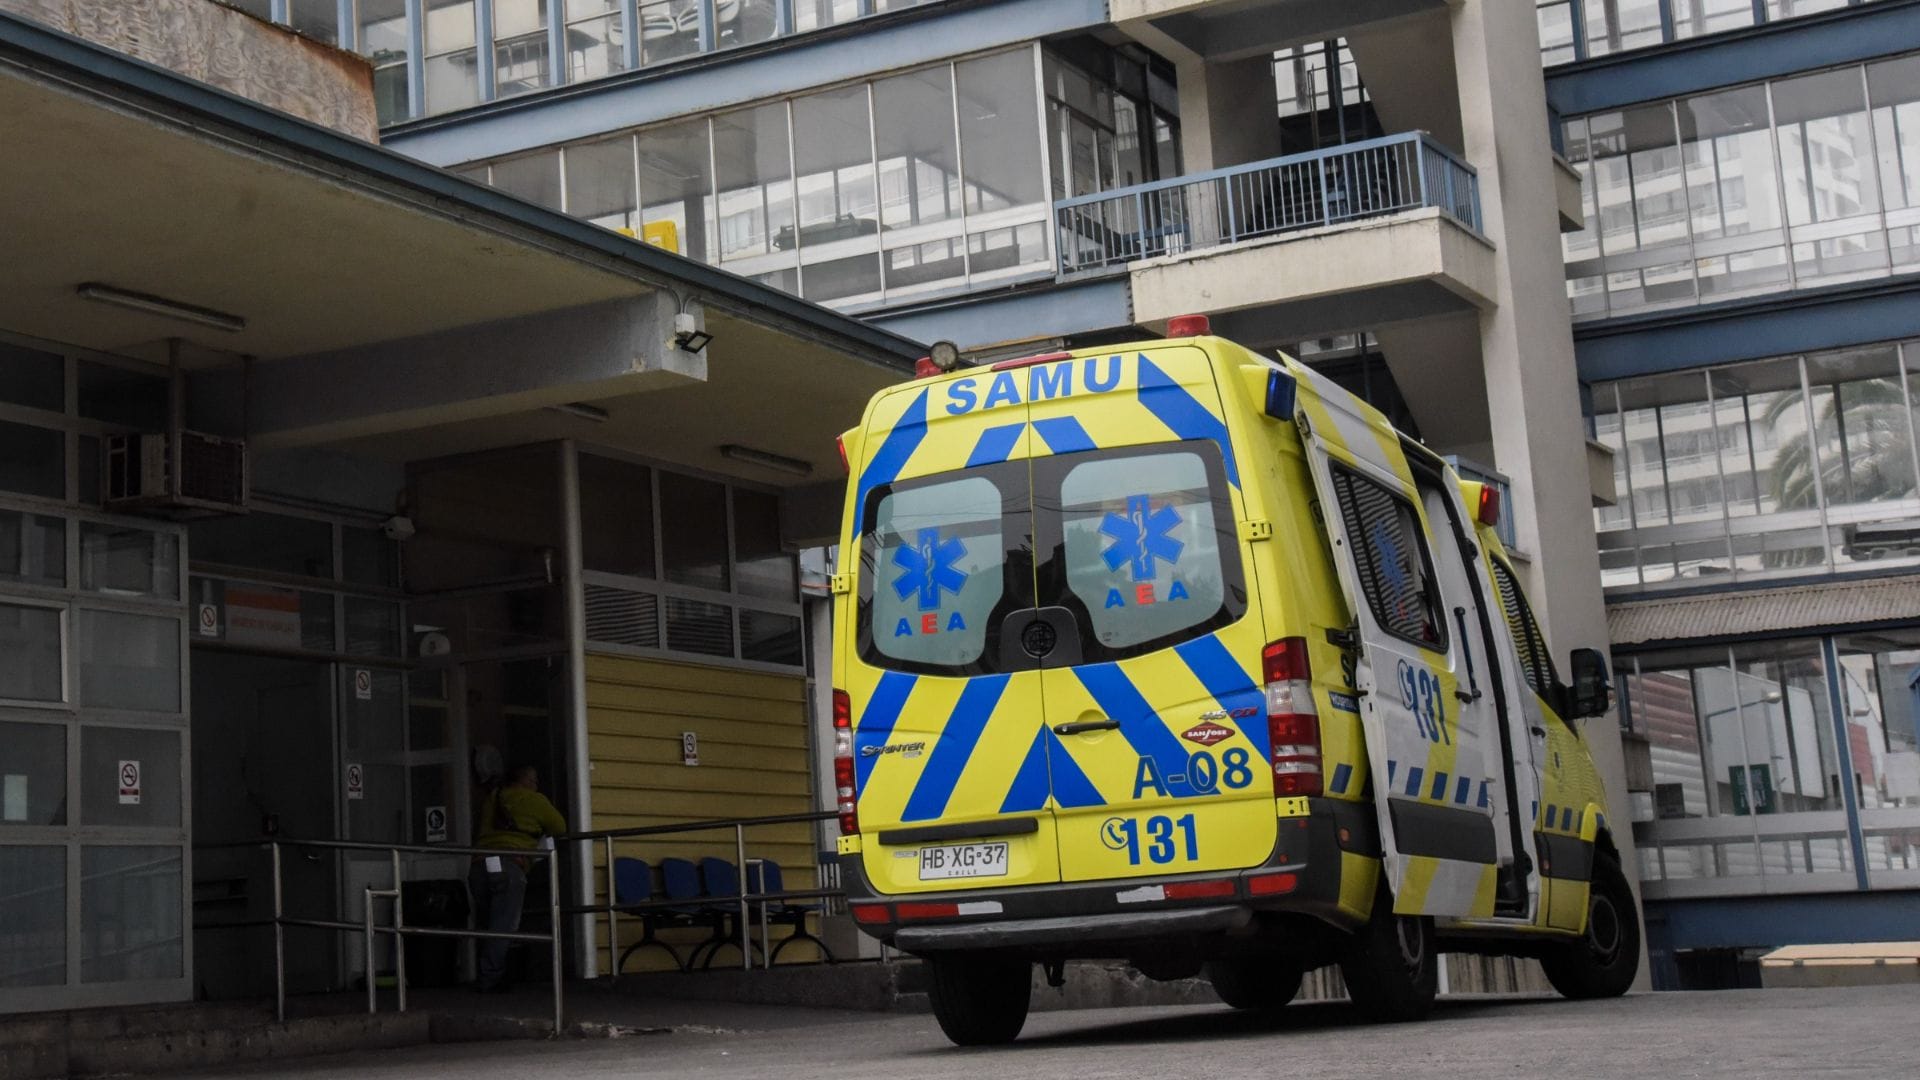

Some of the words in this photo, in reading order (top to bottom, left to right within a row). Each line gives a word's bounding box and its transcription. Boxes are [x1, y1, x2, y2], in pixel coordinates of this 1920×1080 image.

[945, 355, 1122, 416] SAMU
[1104, 580, 1189, 609] AEA
[895, 611, 967, 637] AEA
[1406, 665, 1450, 746] 131
[1132, 747, 1254, 800] A-08
[1119, 813, 1199, 866] 131
